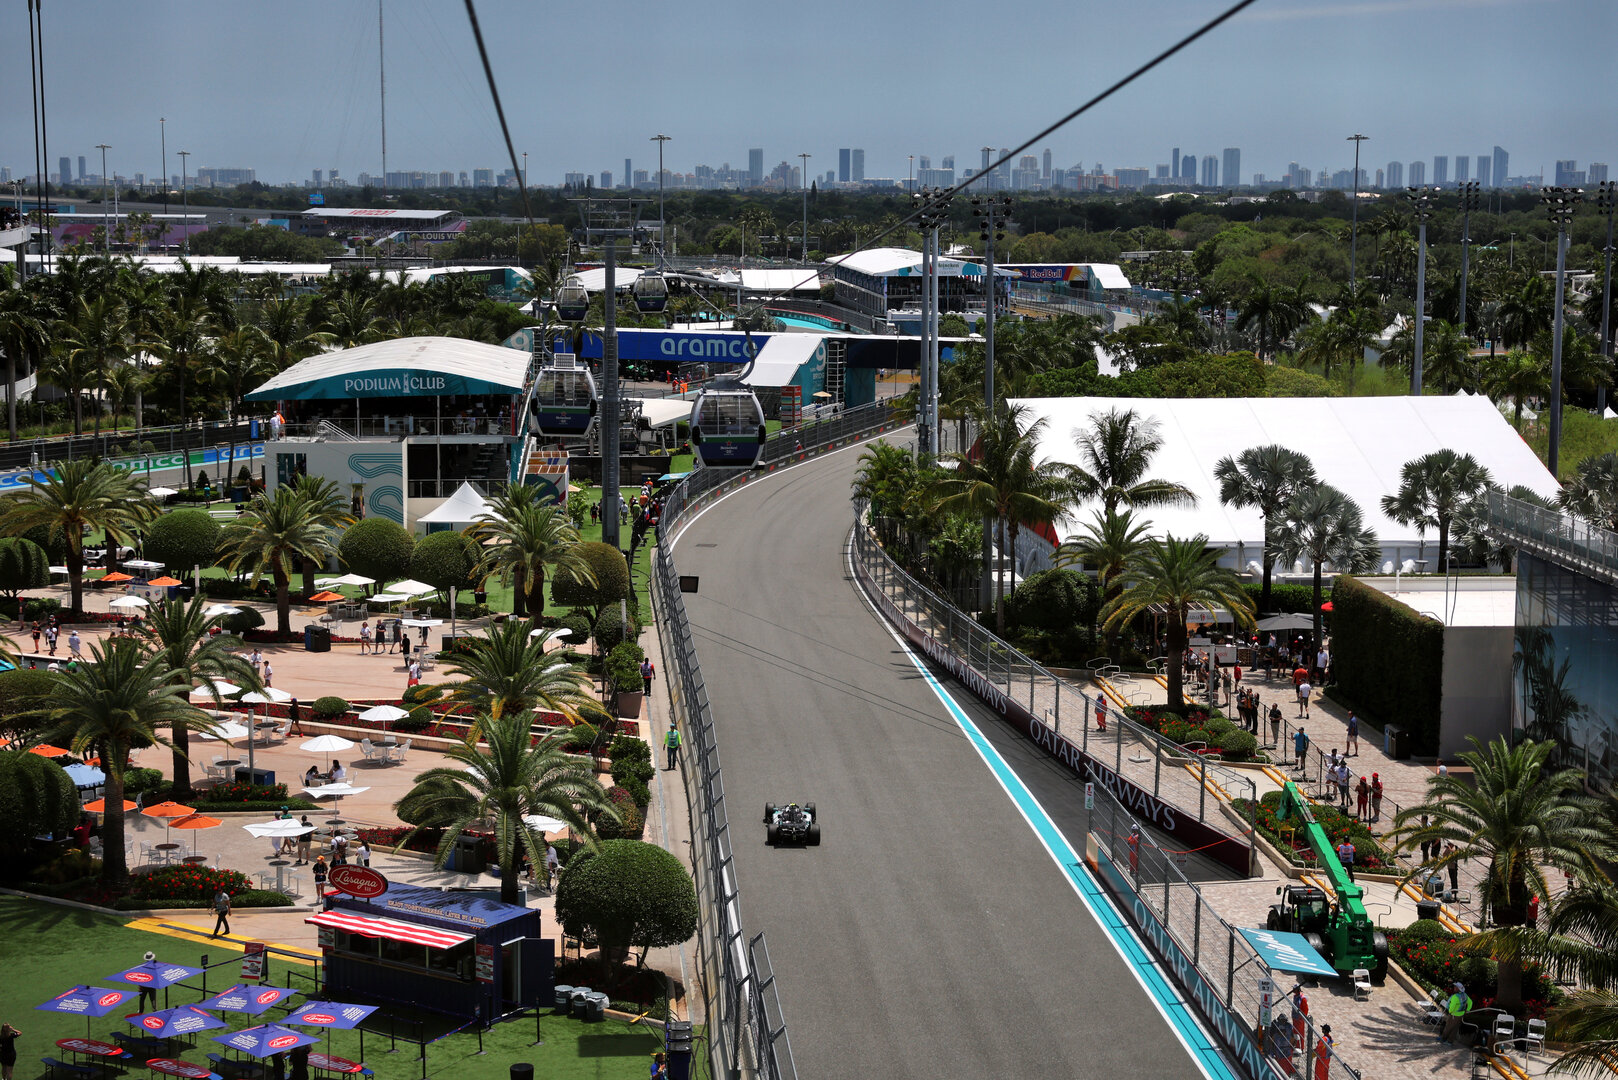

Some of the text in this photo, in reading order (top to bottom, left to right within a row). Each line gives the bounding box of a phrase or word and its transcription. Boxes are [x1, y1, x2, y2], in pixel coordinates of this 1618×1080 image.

[422, 232, 446, 240] LOUIS
[471, 273, 492, 282] ZERO
[1030, 268, 1063, 279] Red Bull
[660, 338, 758, 358] aramco
[816, 341, 826, 371] 9
[344, 376, 446, 391] PODIUM CLUB
[923, 636, 1007, 714] QATAR AIRWAYS
[1029, 718, 1176, 831] QATAR AIRWAYS
[335, 870, 378, 889] Lasagna
[1134, 899, 1280, 1080] QATAR AIRWAY
